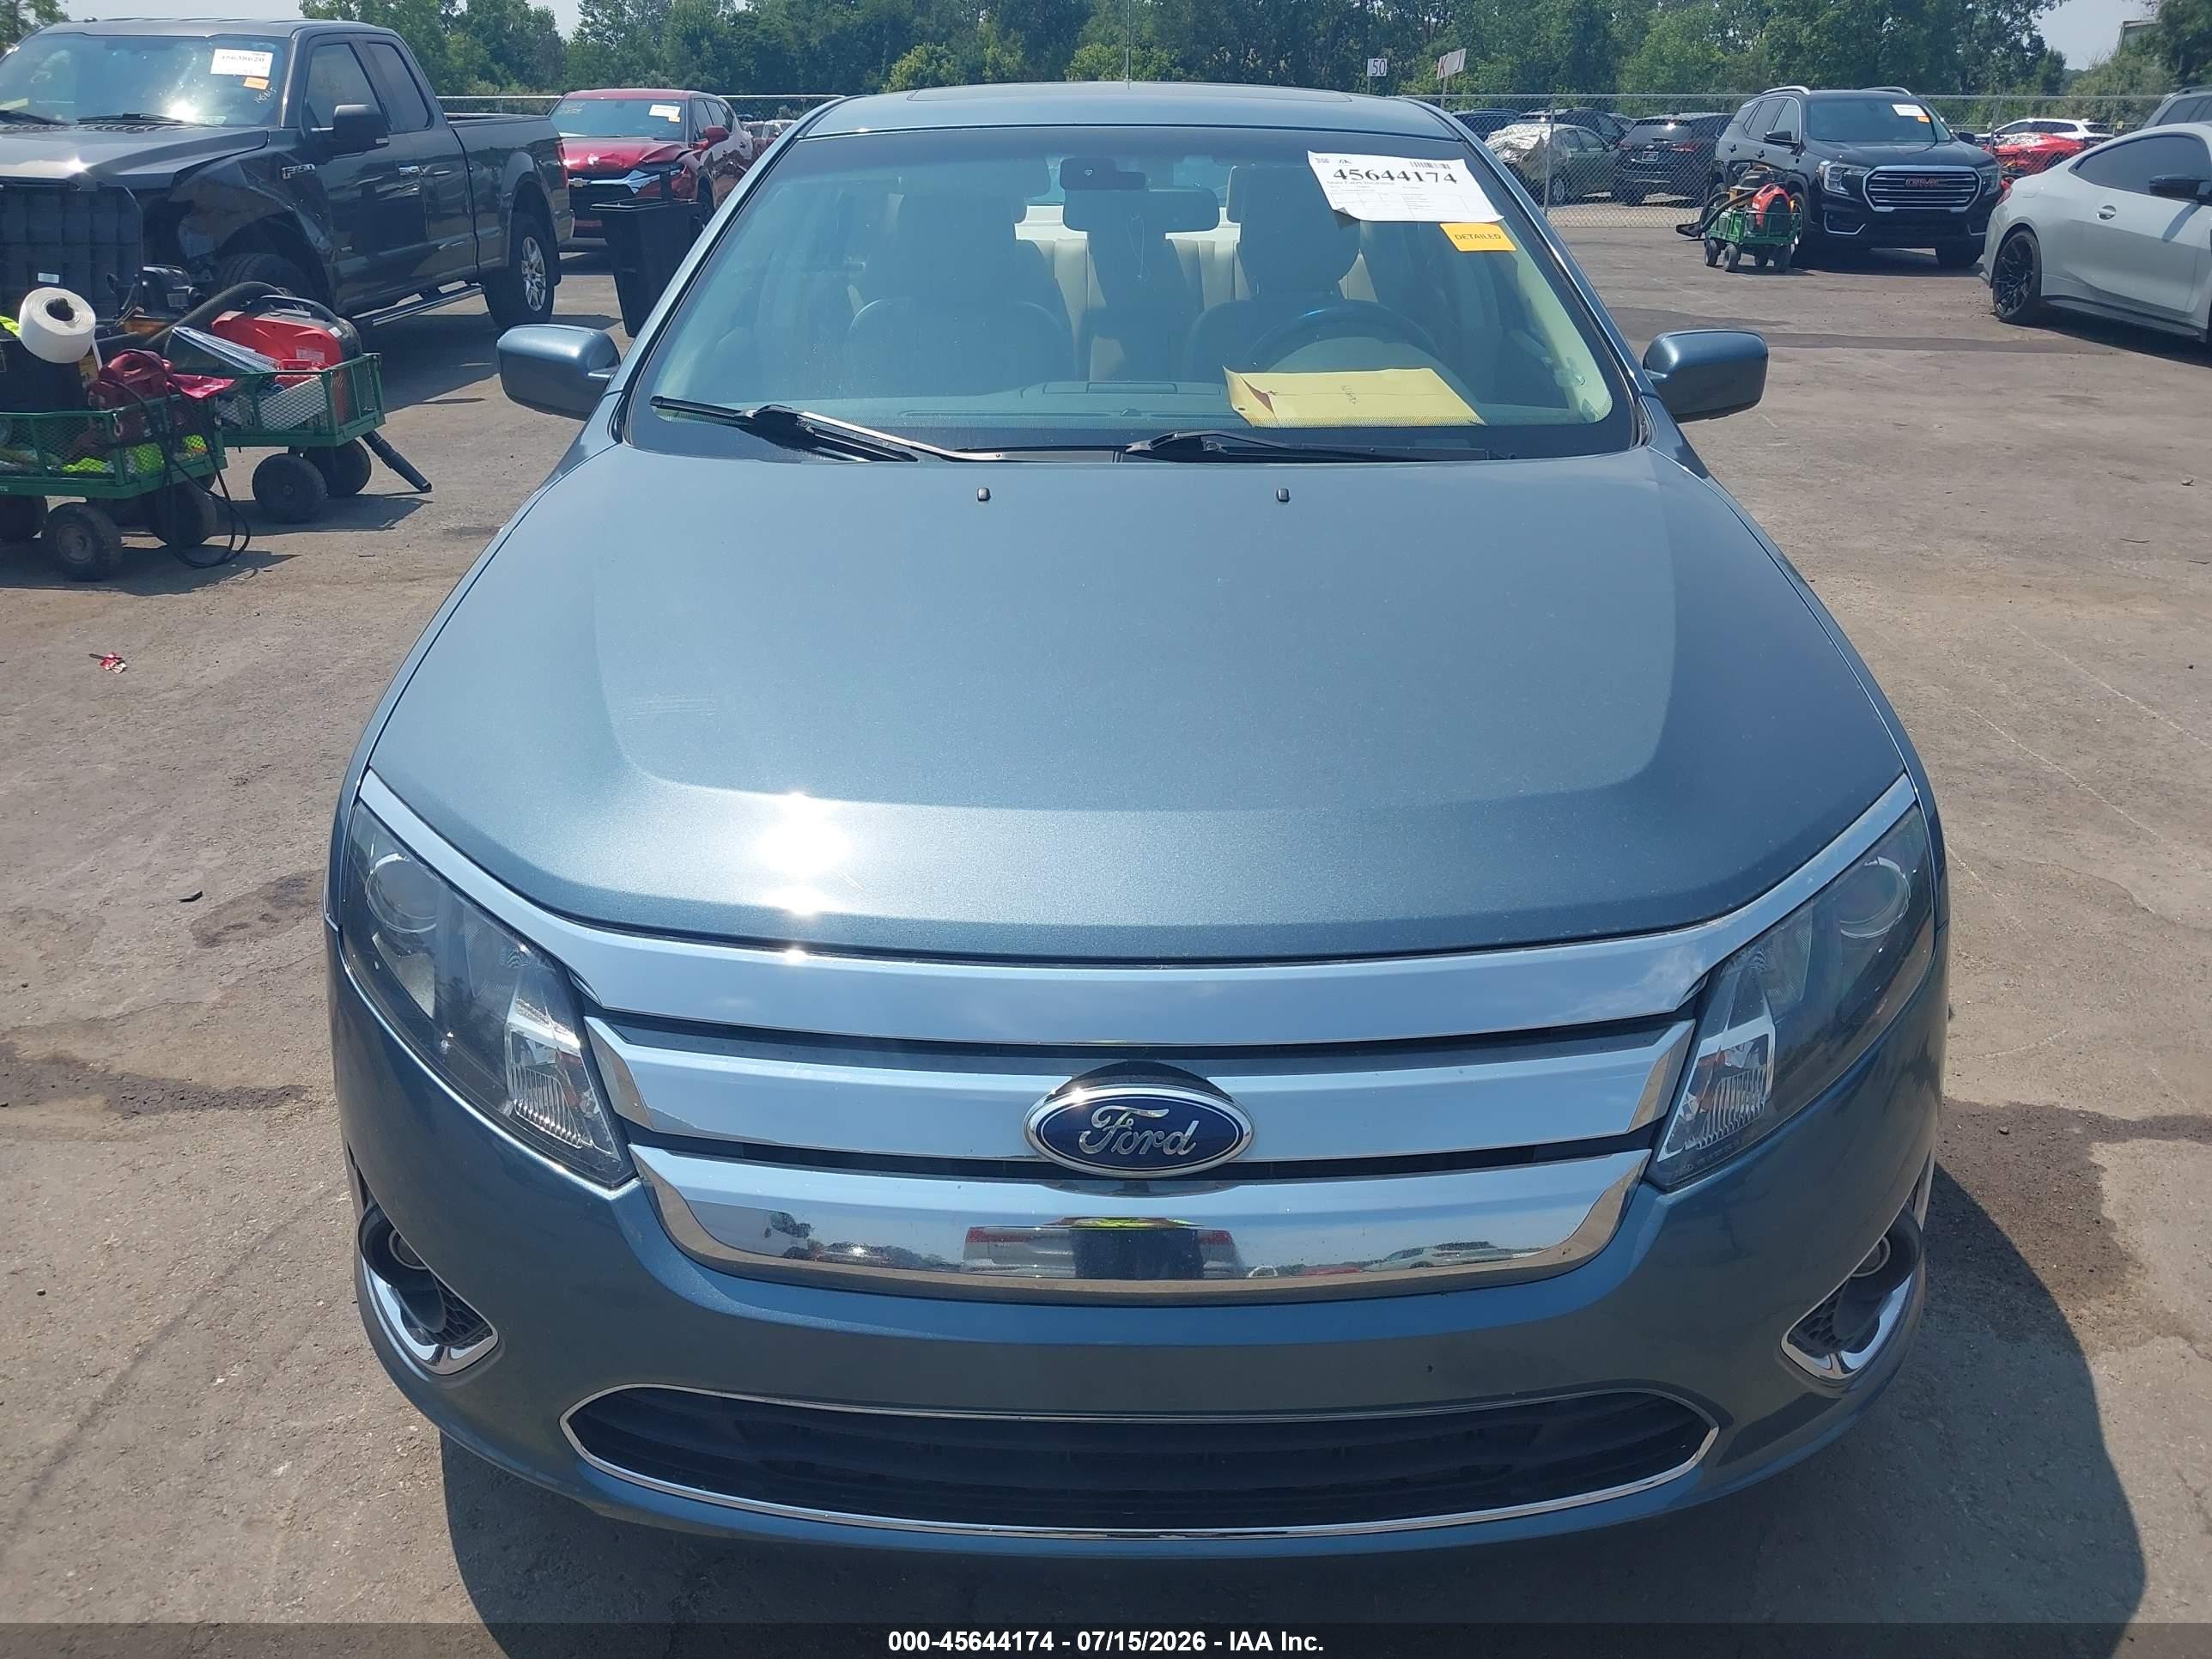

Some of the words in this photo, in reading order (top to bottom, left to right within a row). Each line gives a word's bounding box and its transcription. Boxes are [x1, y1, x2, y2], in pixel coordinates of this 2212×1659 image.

[1372, 59, 1386, 76] 50
[1438, 56, 1448, 76] K
[1455, 51, 1462, 72] J
[1333, 168, 1458, 184] 45644174
[1079, 1105, 1200, 1156] Ford
